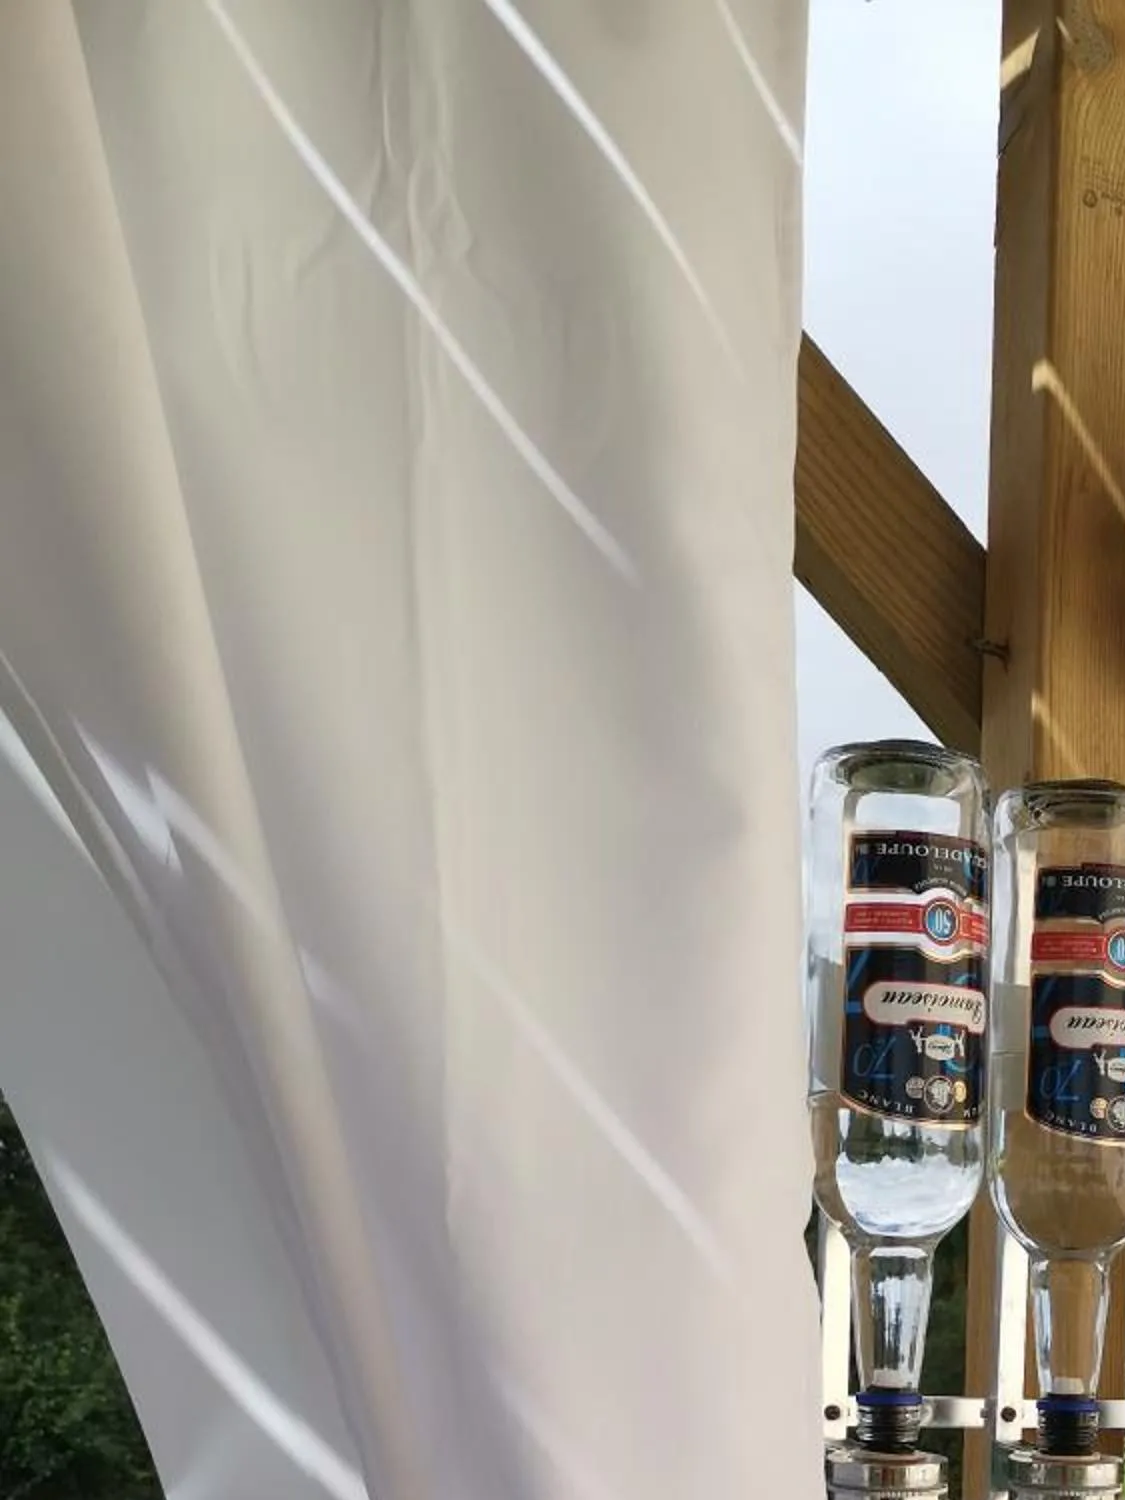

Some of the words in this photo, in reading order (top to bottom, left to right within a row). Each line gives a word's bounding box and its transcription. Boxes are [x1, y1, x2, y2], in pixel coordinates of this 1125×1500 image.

[933, 907, 953, 935] 50
[856, 1088, 915, 1115] BLANC
[1043, 1109, 1098, 1133] BLANC
